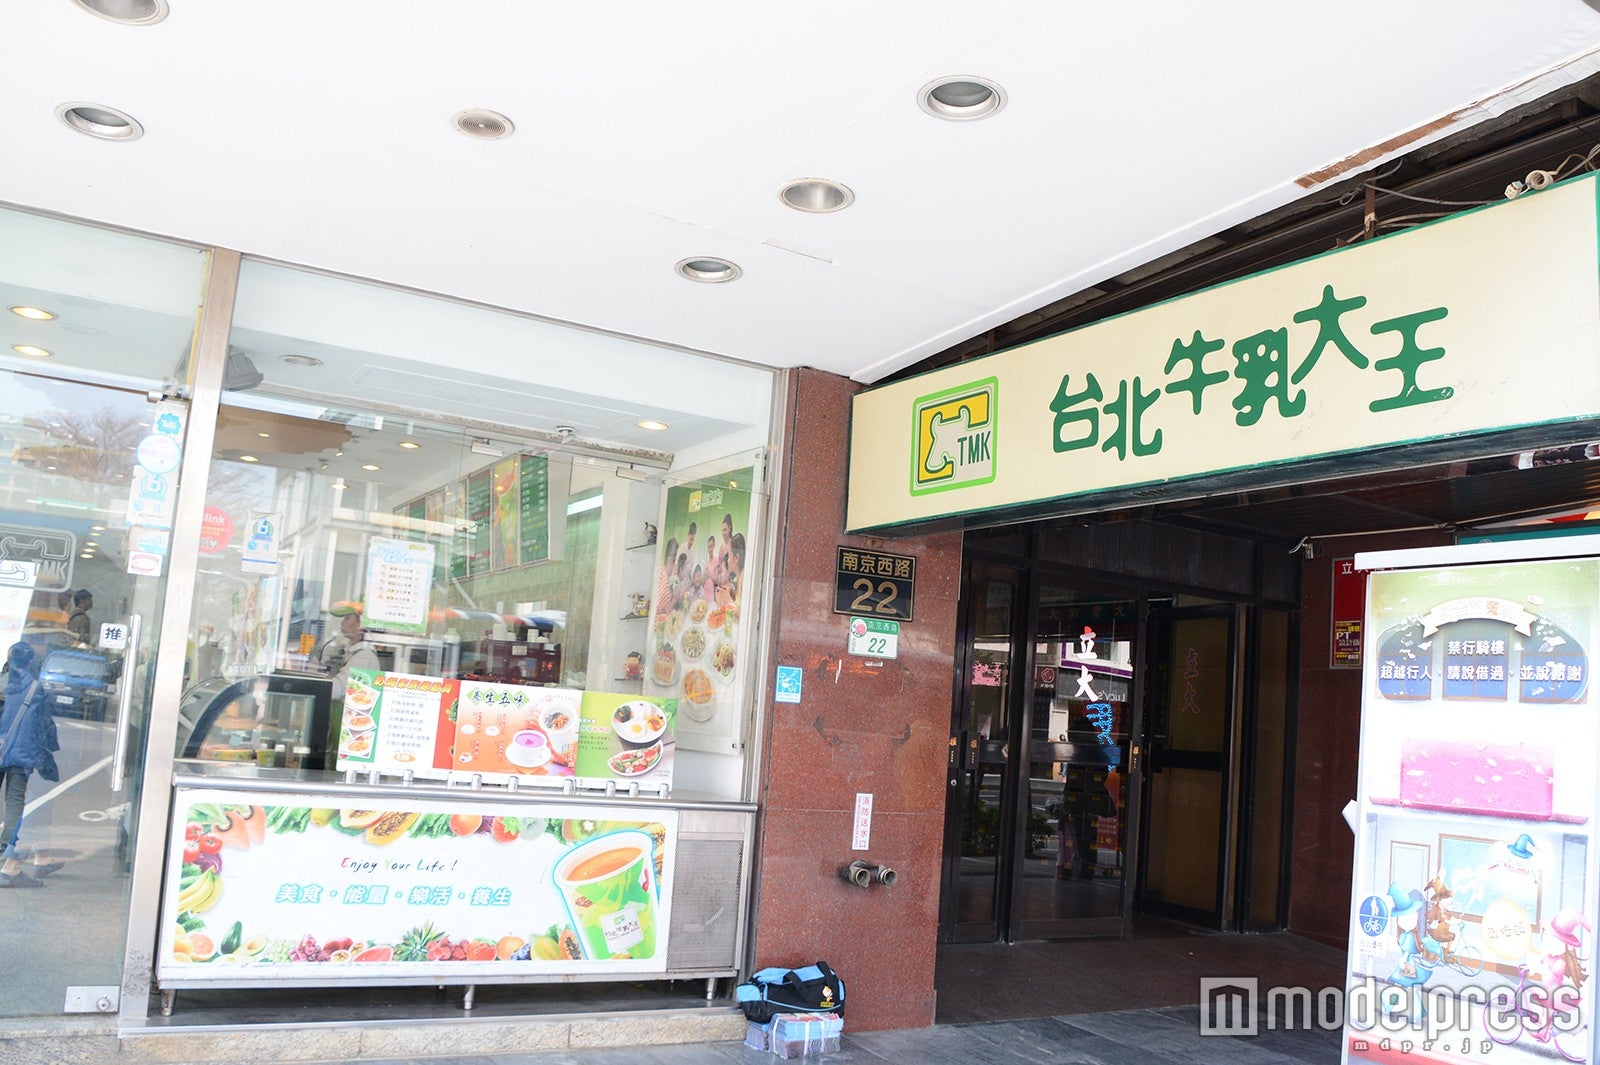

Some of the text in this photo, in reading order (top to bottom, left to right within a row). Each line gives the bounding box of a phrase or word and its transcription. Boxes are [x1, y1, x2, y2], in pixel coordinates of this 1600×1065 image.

[1049, 284, 1455, 461] 台北牛乳大王
[957, 430, 991, 466] TMK
[842, 551, 911, 579] 南京西路
[850, 577, 898, 614] 22
[105, 627, 121, 641] 推
[867, 637, 887, 654] 22
[1447, 640, 1505, 656] 禁行騎樓
[341, 857, 378, 873] Enjoy
[385, 858, 411, 870] Your
[416, 858, 446, 873] Life
